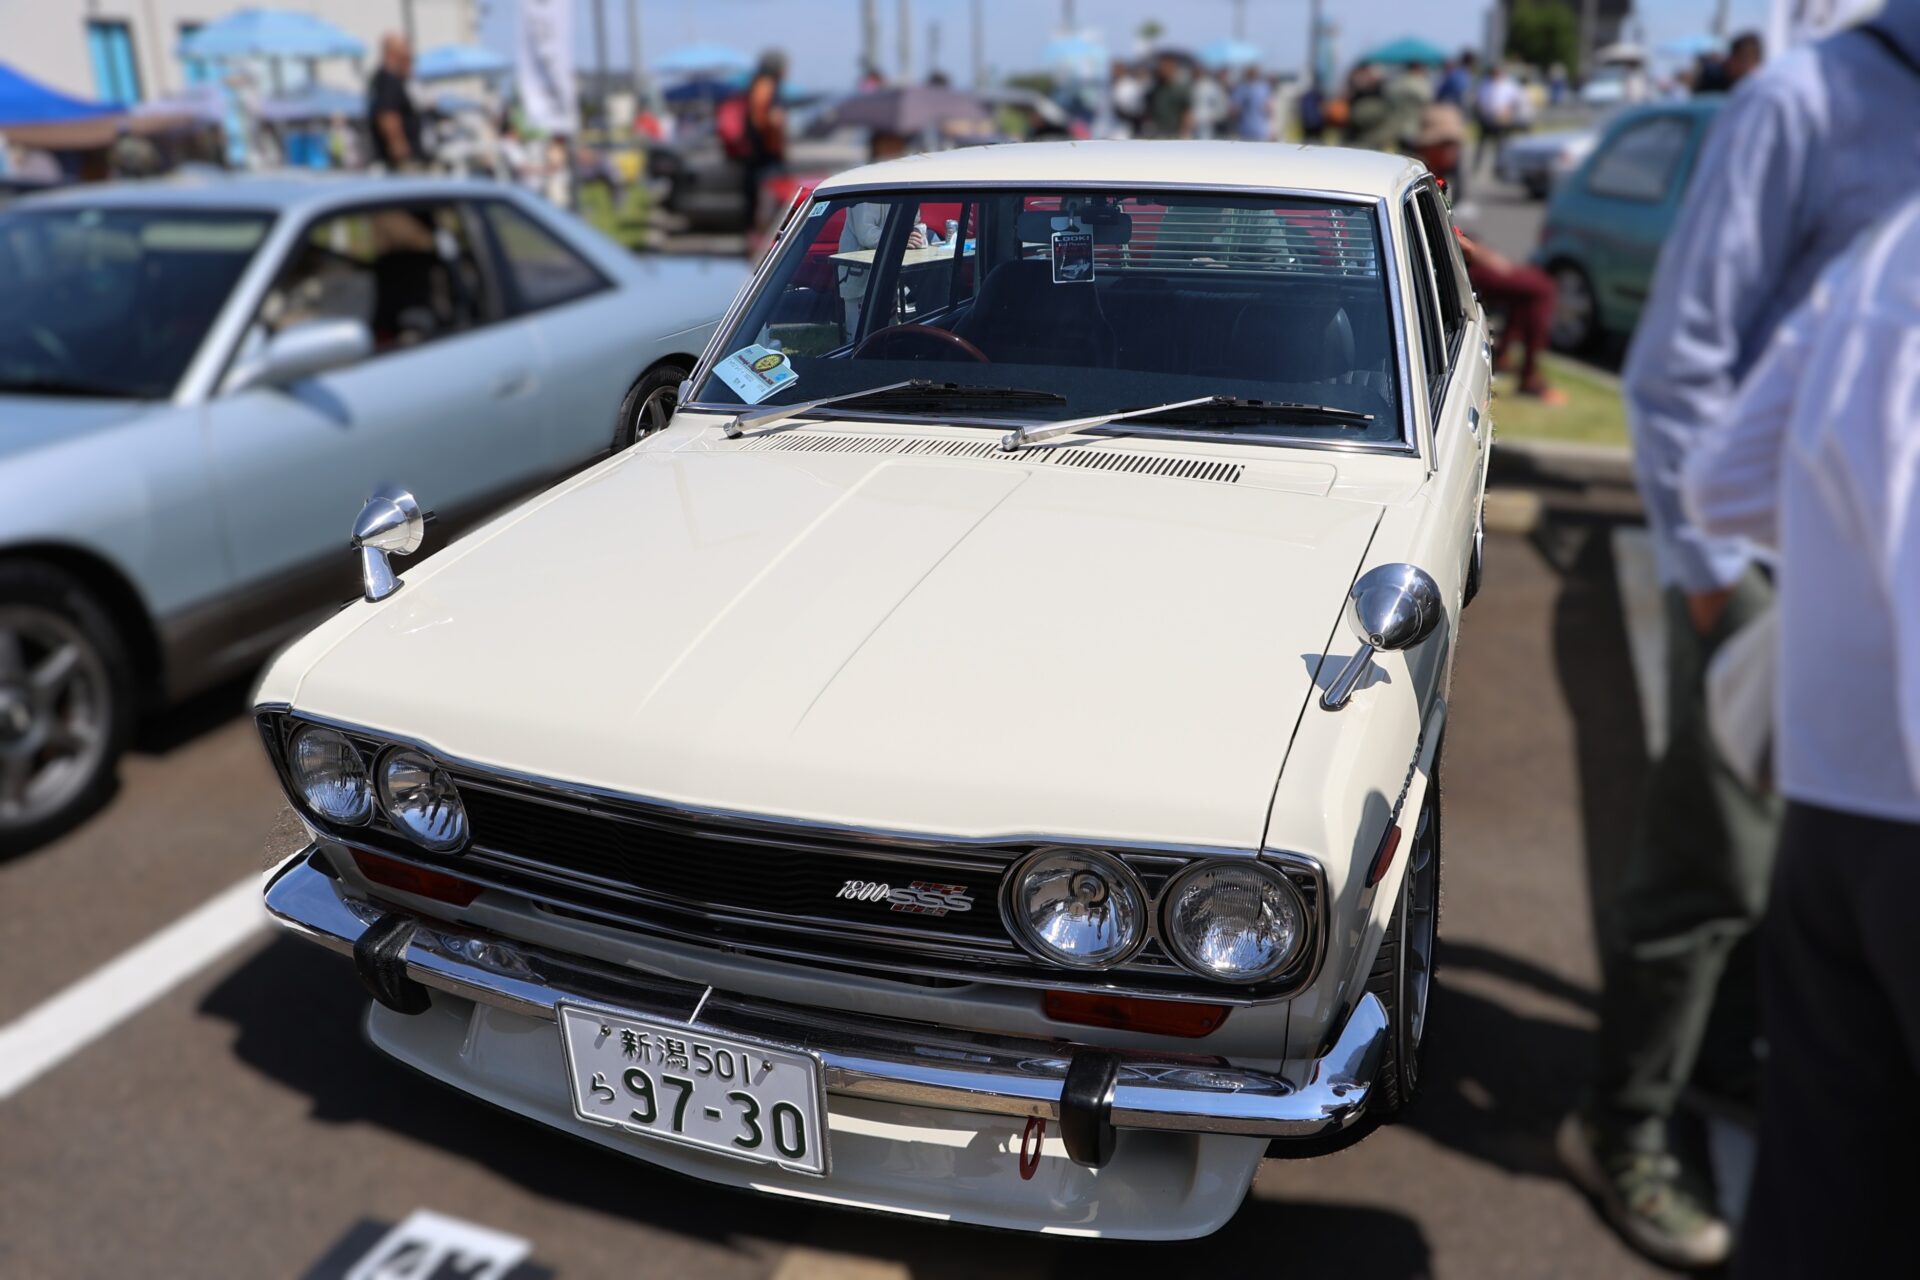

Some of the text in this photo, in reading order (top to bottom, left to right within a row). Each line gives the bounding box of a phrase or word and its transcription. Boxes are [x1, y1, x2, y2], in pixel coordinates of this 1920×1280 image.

[835, 880, 975, 911] 1800 SSS
[591, 1067, 807, 1159] ら 97-30
